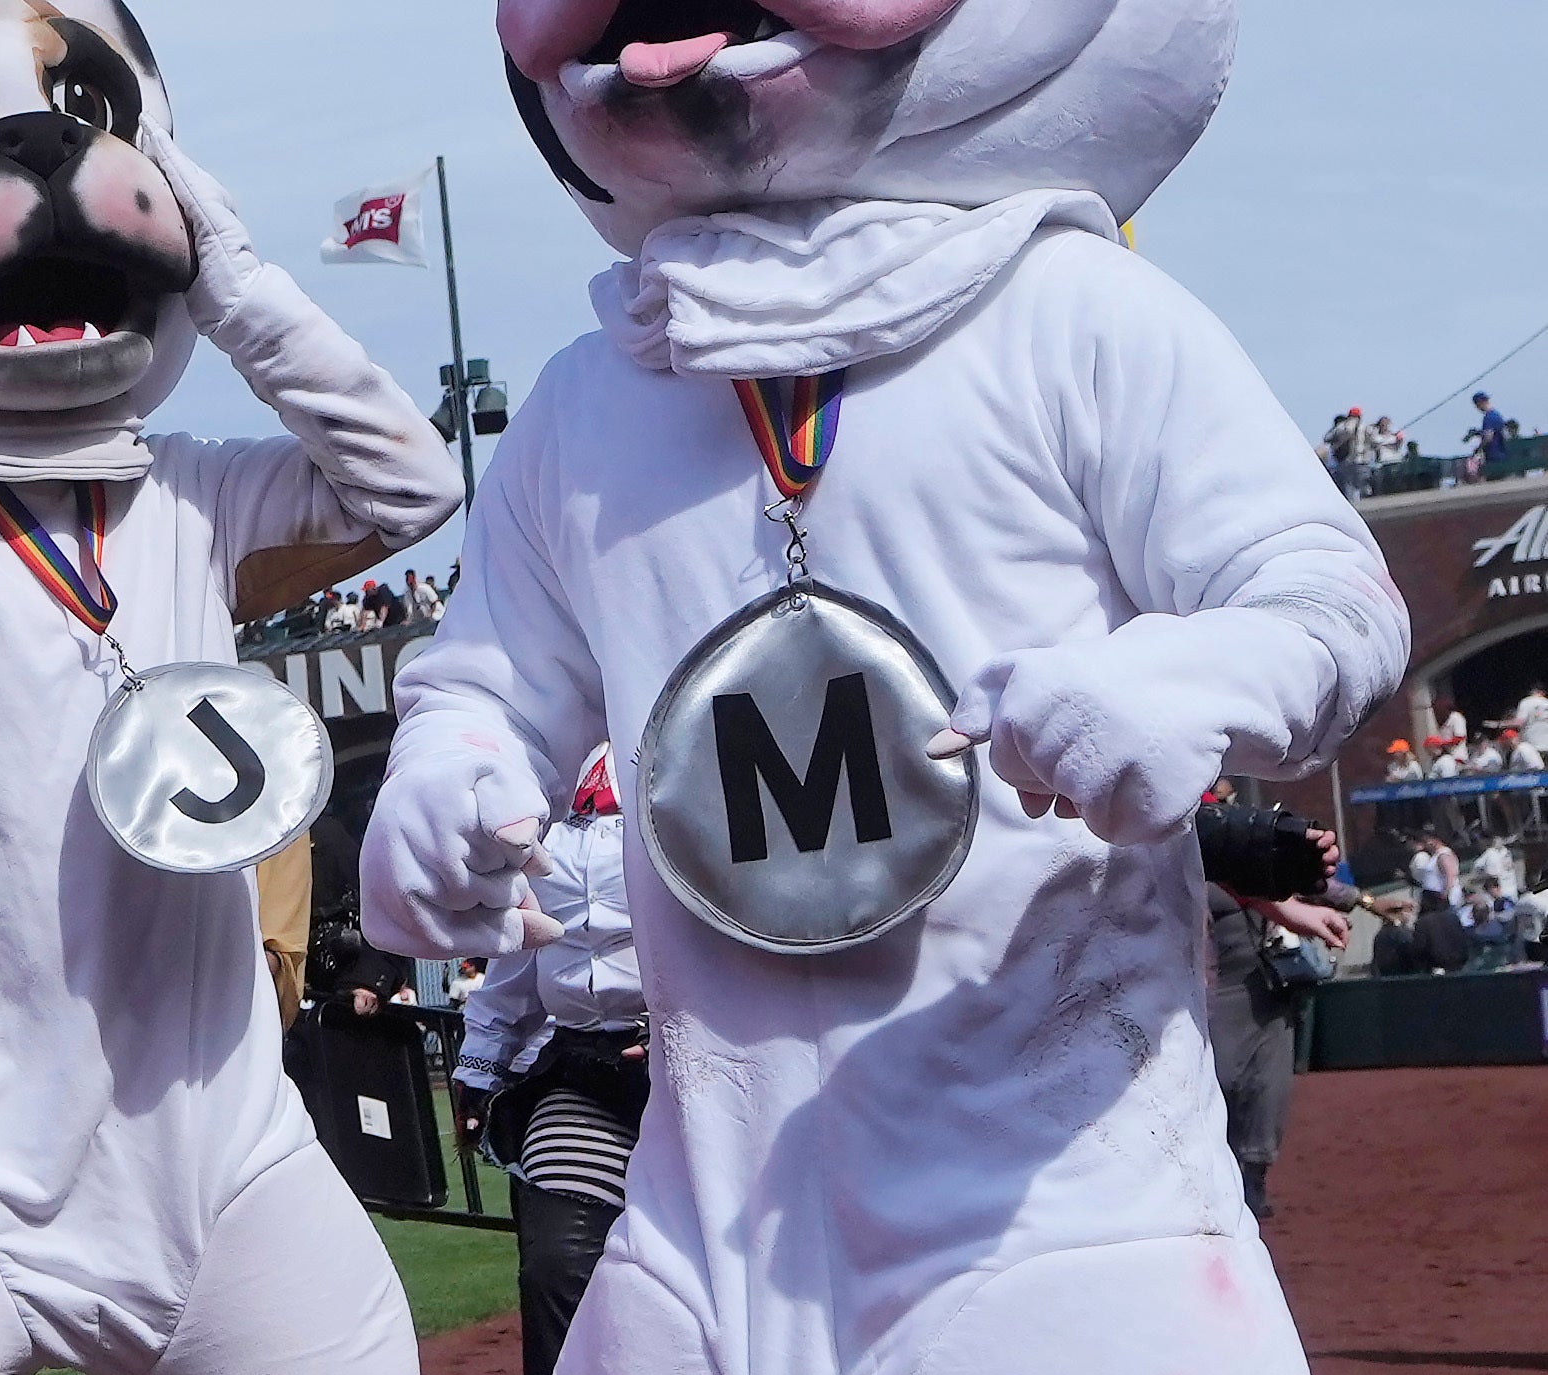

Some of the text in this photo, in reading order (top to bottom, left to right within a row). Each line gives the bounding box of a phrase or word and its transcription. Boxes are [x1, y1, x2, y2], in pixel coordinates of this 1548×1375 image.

[1487, 573, 1548, 599] AIR
[168, 696, 266, 825] J
[712, 671, 893, 865] M
